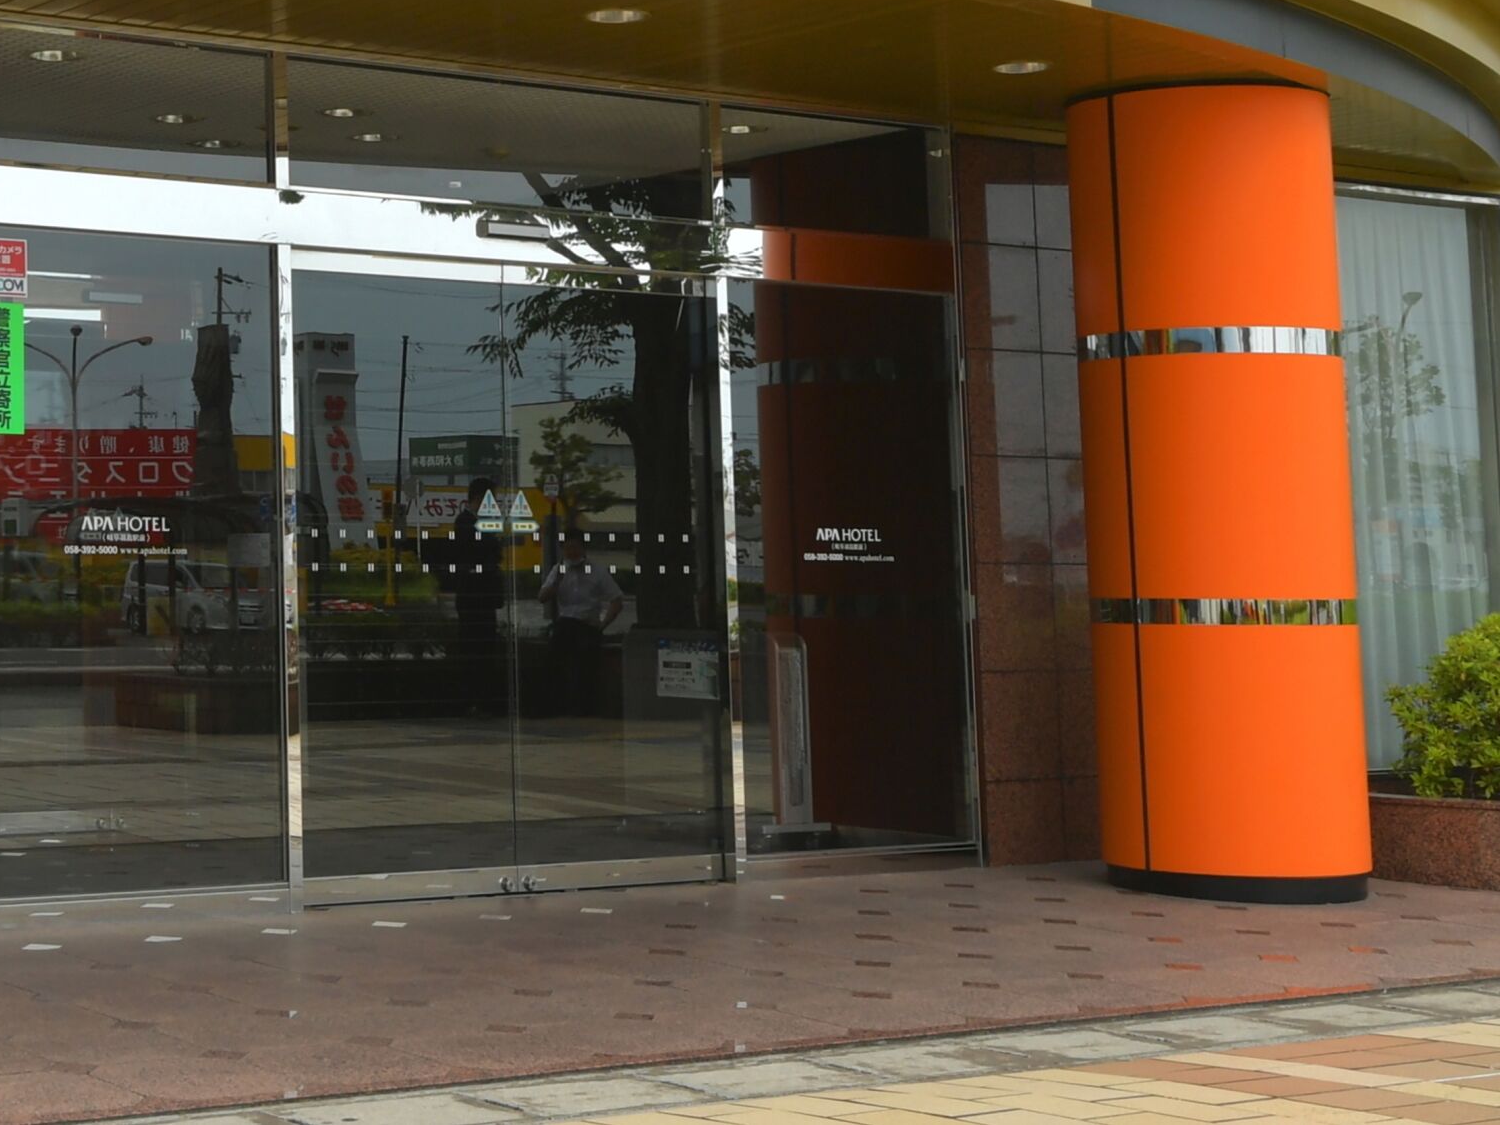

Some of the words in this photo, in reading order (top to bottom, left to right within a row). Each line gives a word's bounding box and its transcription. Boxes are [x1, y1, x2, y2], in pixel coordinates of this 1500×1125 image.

[81, 515, 113, 531] APA
[117, 516, 170, 532] HOTEL
[816, 528, 840, 542] APA
[842, 529, 882, 542] HOTEL
[64, 545, 118, 555] 058-392-5000
[120, 546, 188, 556] www.apahotel.com
